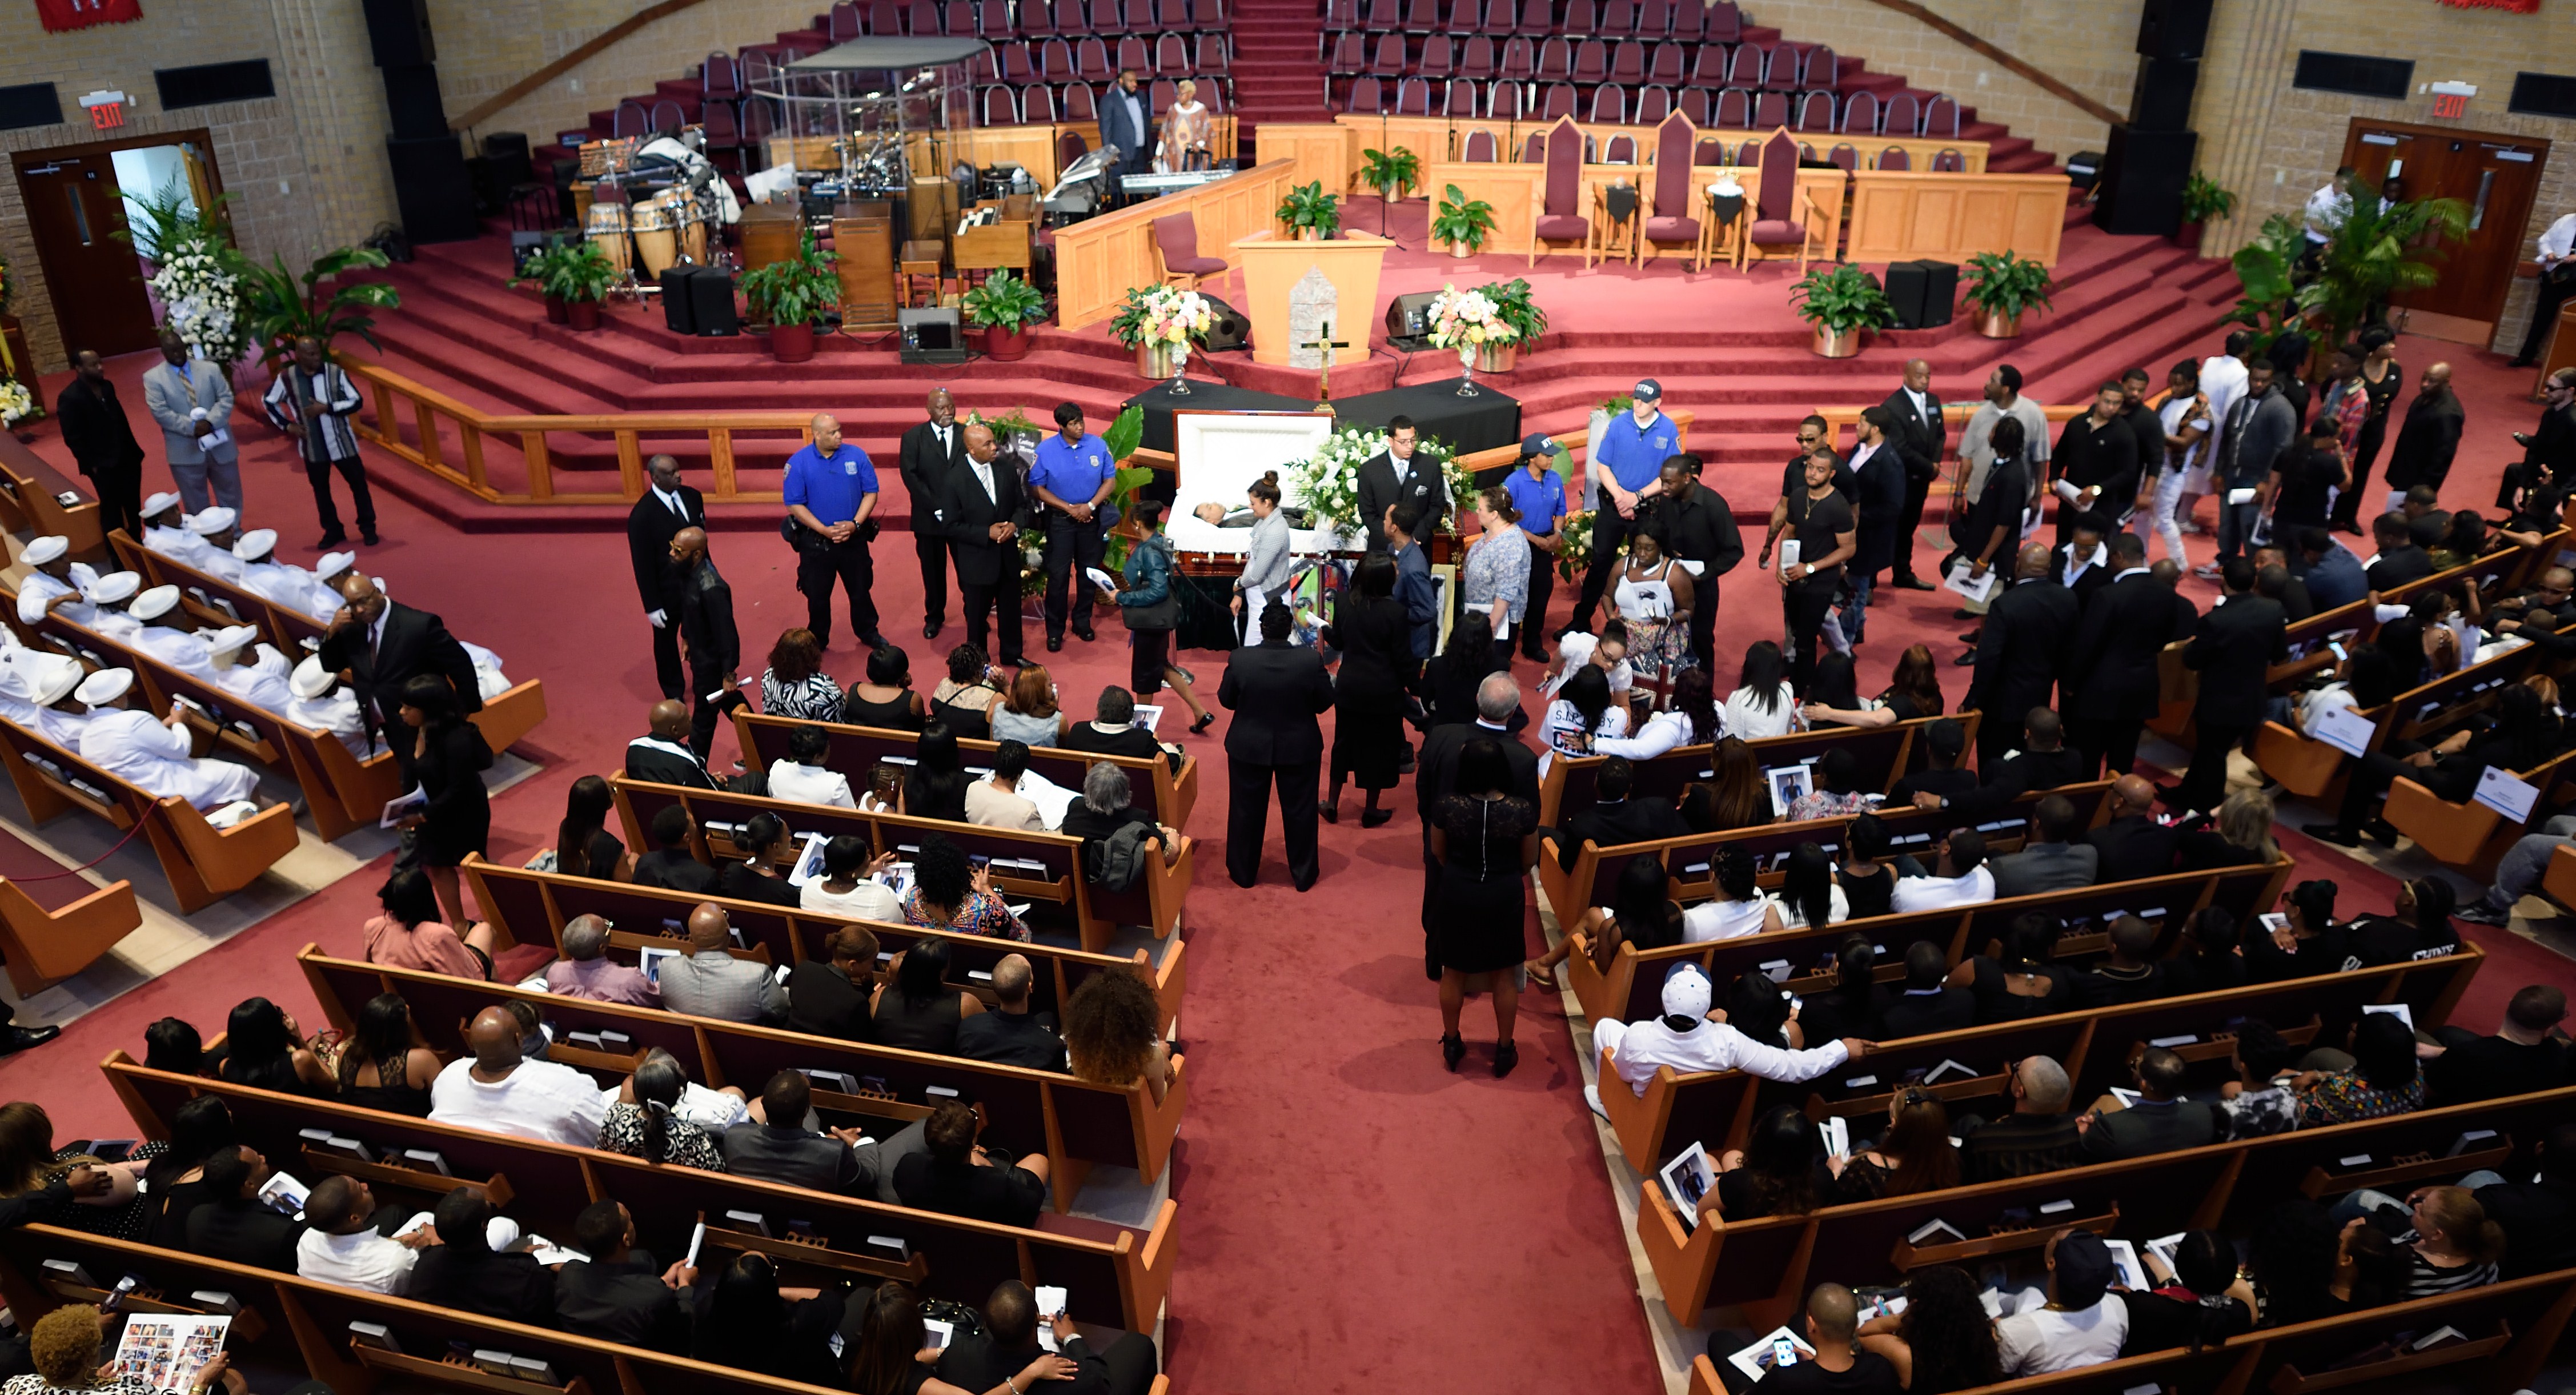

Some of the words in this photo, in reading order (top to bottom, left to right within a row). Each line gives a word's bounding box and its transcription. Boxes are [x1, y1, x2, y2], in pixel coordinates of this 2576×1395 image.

[2433, 93, 2467, 119] EXIT
[91, 102, 123, 130] EXIT
[1636, 383, 1654, 396] NYPD
[1540, 437, 1553, 449] NY
